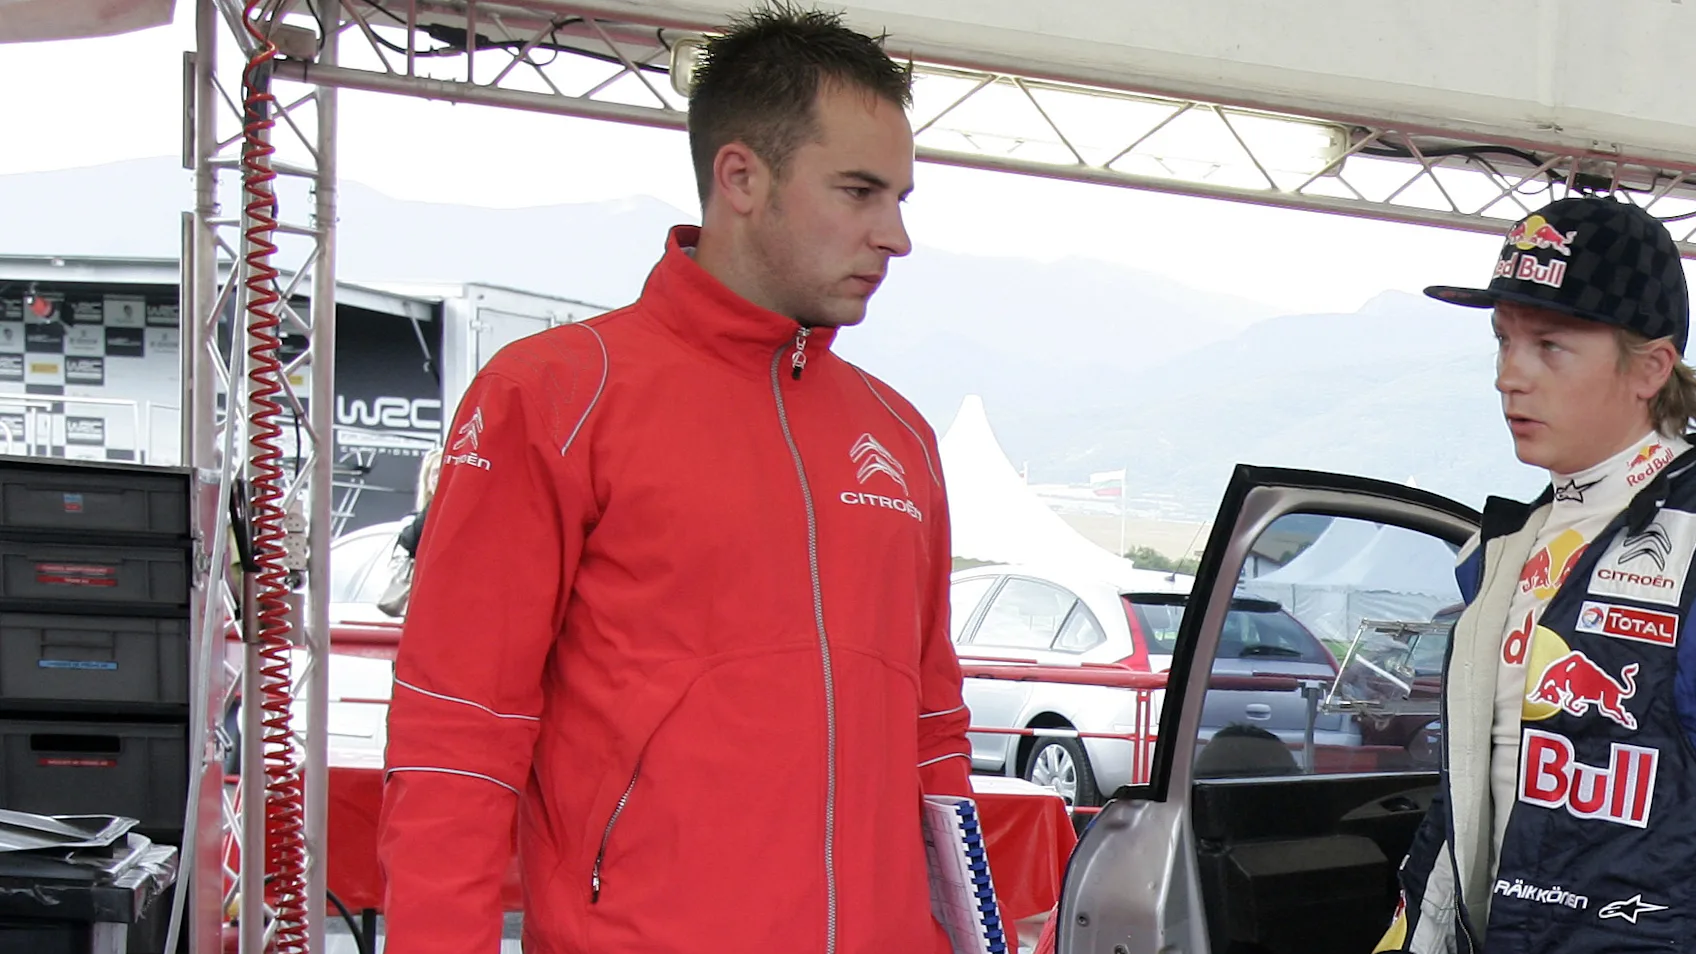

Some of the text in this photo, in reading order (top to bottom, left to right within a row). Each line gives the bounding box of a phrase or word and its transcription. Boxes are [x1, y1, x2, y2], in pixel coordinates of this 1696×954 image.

[1493, 252, 1567, 288] ed Bull
[337, 395, 441, 429] WRC
[1626, 447, 1675, 487] Red Bull
[840, 491, 922, 523] CITROËN
[1597, 569, 1675, 589] CITROËN
[1609, 612, 1673, 638] TOTAL
[1518, 728, 1659, 827] Bull
[1494, 879, 1588, 909] RÄIKKÖNEN
